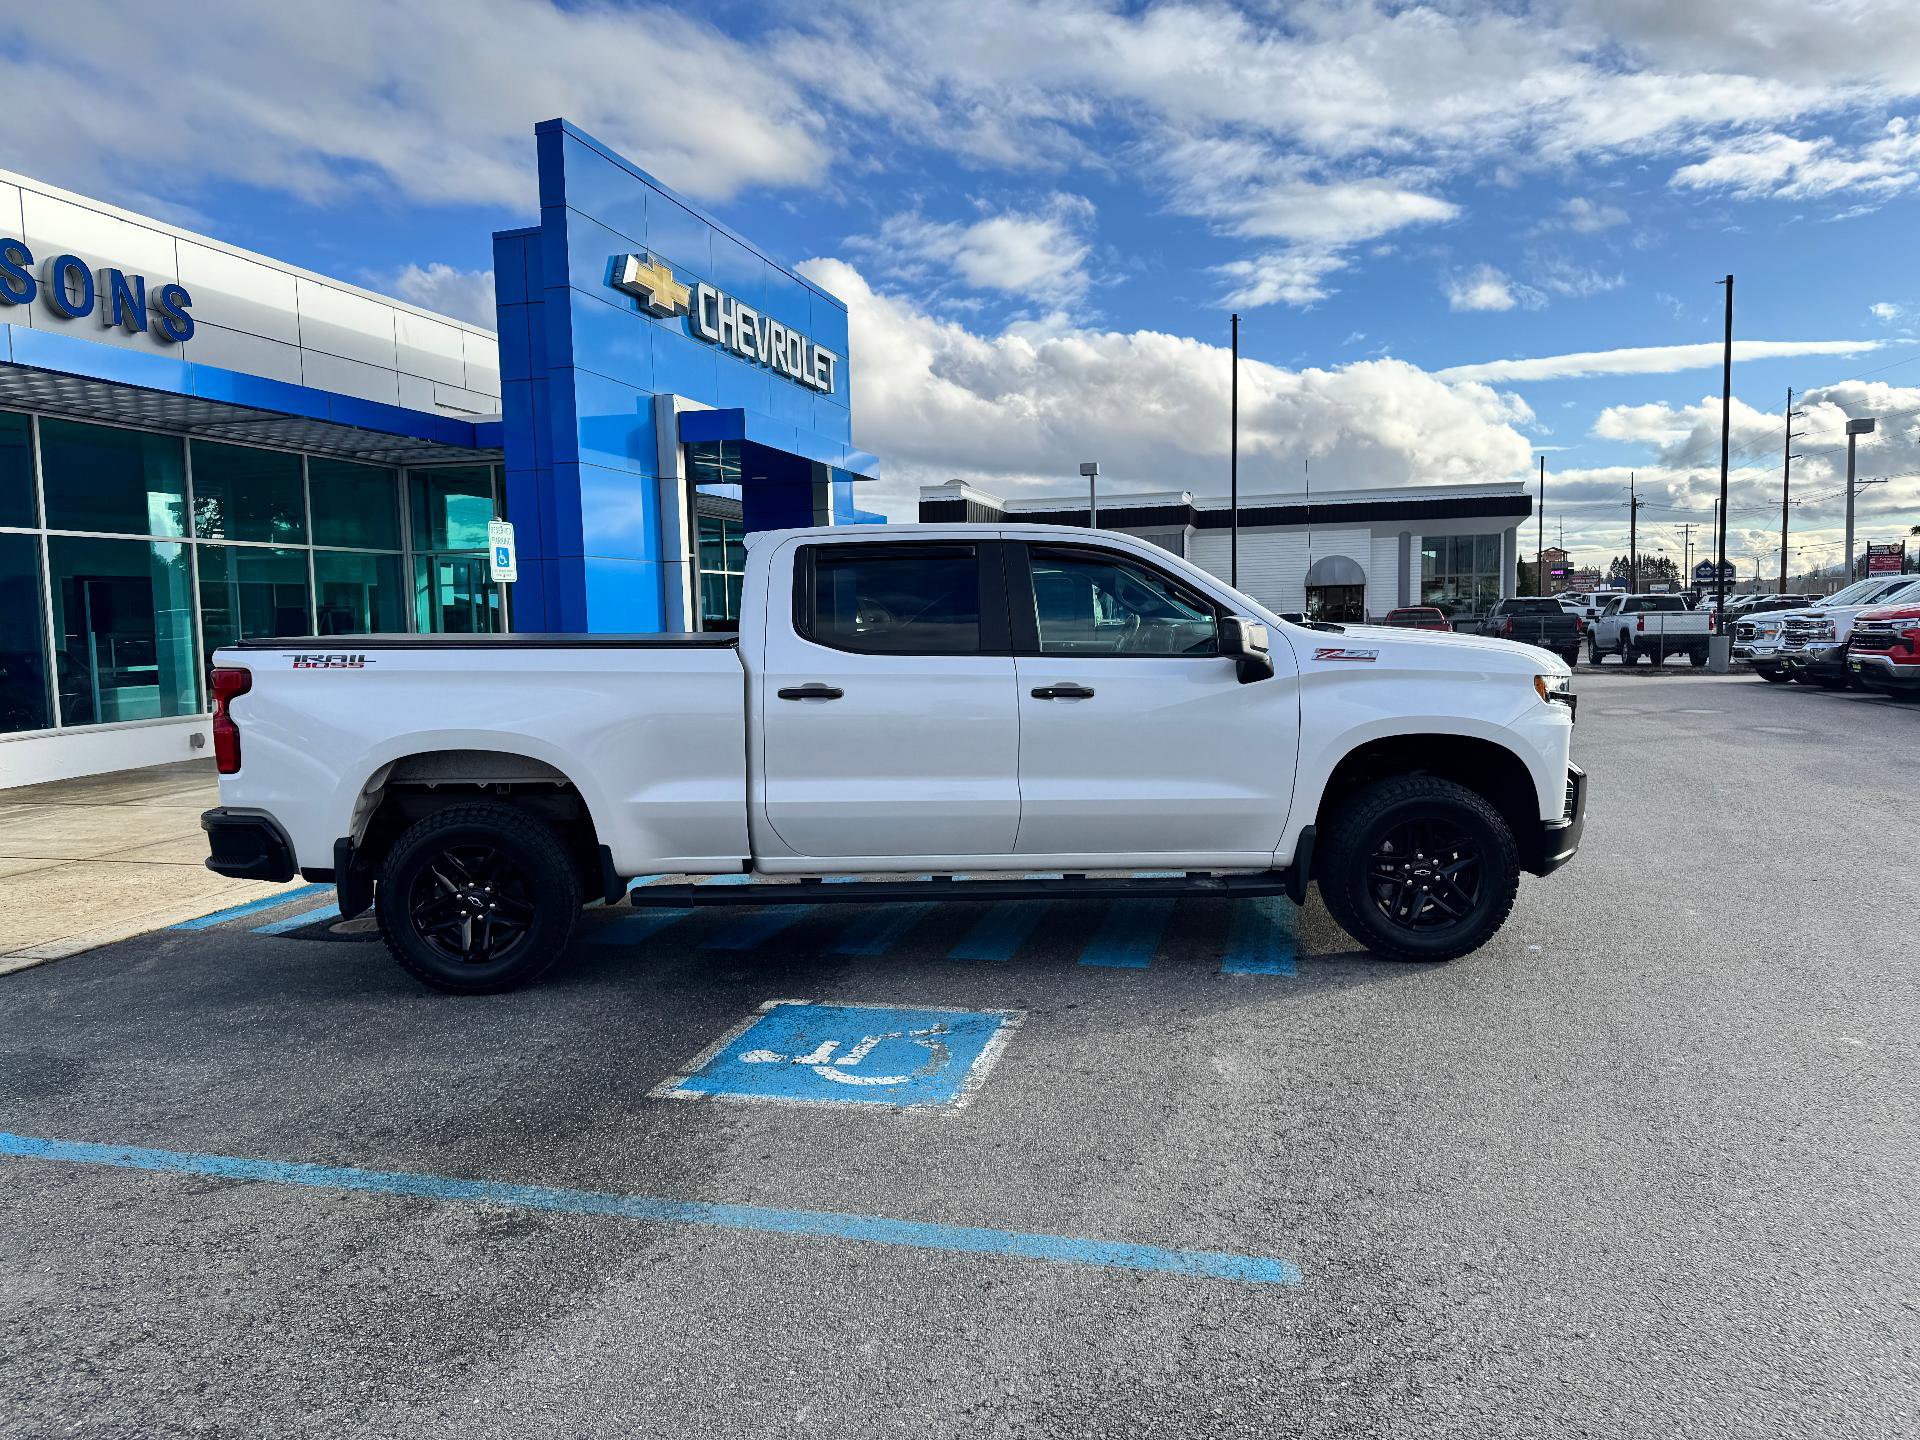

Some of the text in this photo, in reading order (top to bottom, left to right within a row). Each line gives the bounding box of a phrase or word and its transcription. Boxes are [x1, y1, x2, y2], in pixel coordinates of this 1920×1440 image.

[0, 238, 195, 343] SONS
[692, 282, 838, 394] CHEVROLET
[283, 654, 376, 663] TRAIL
[1312, 648, 1380, 662] Z71
